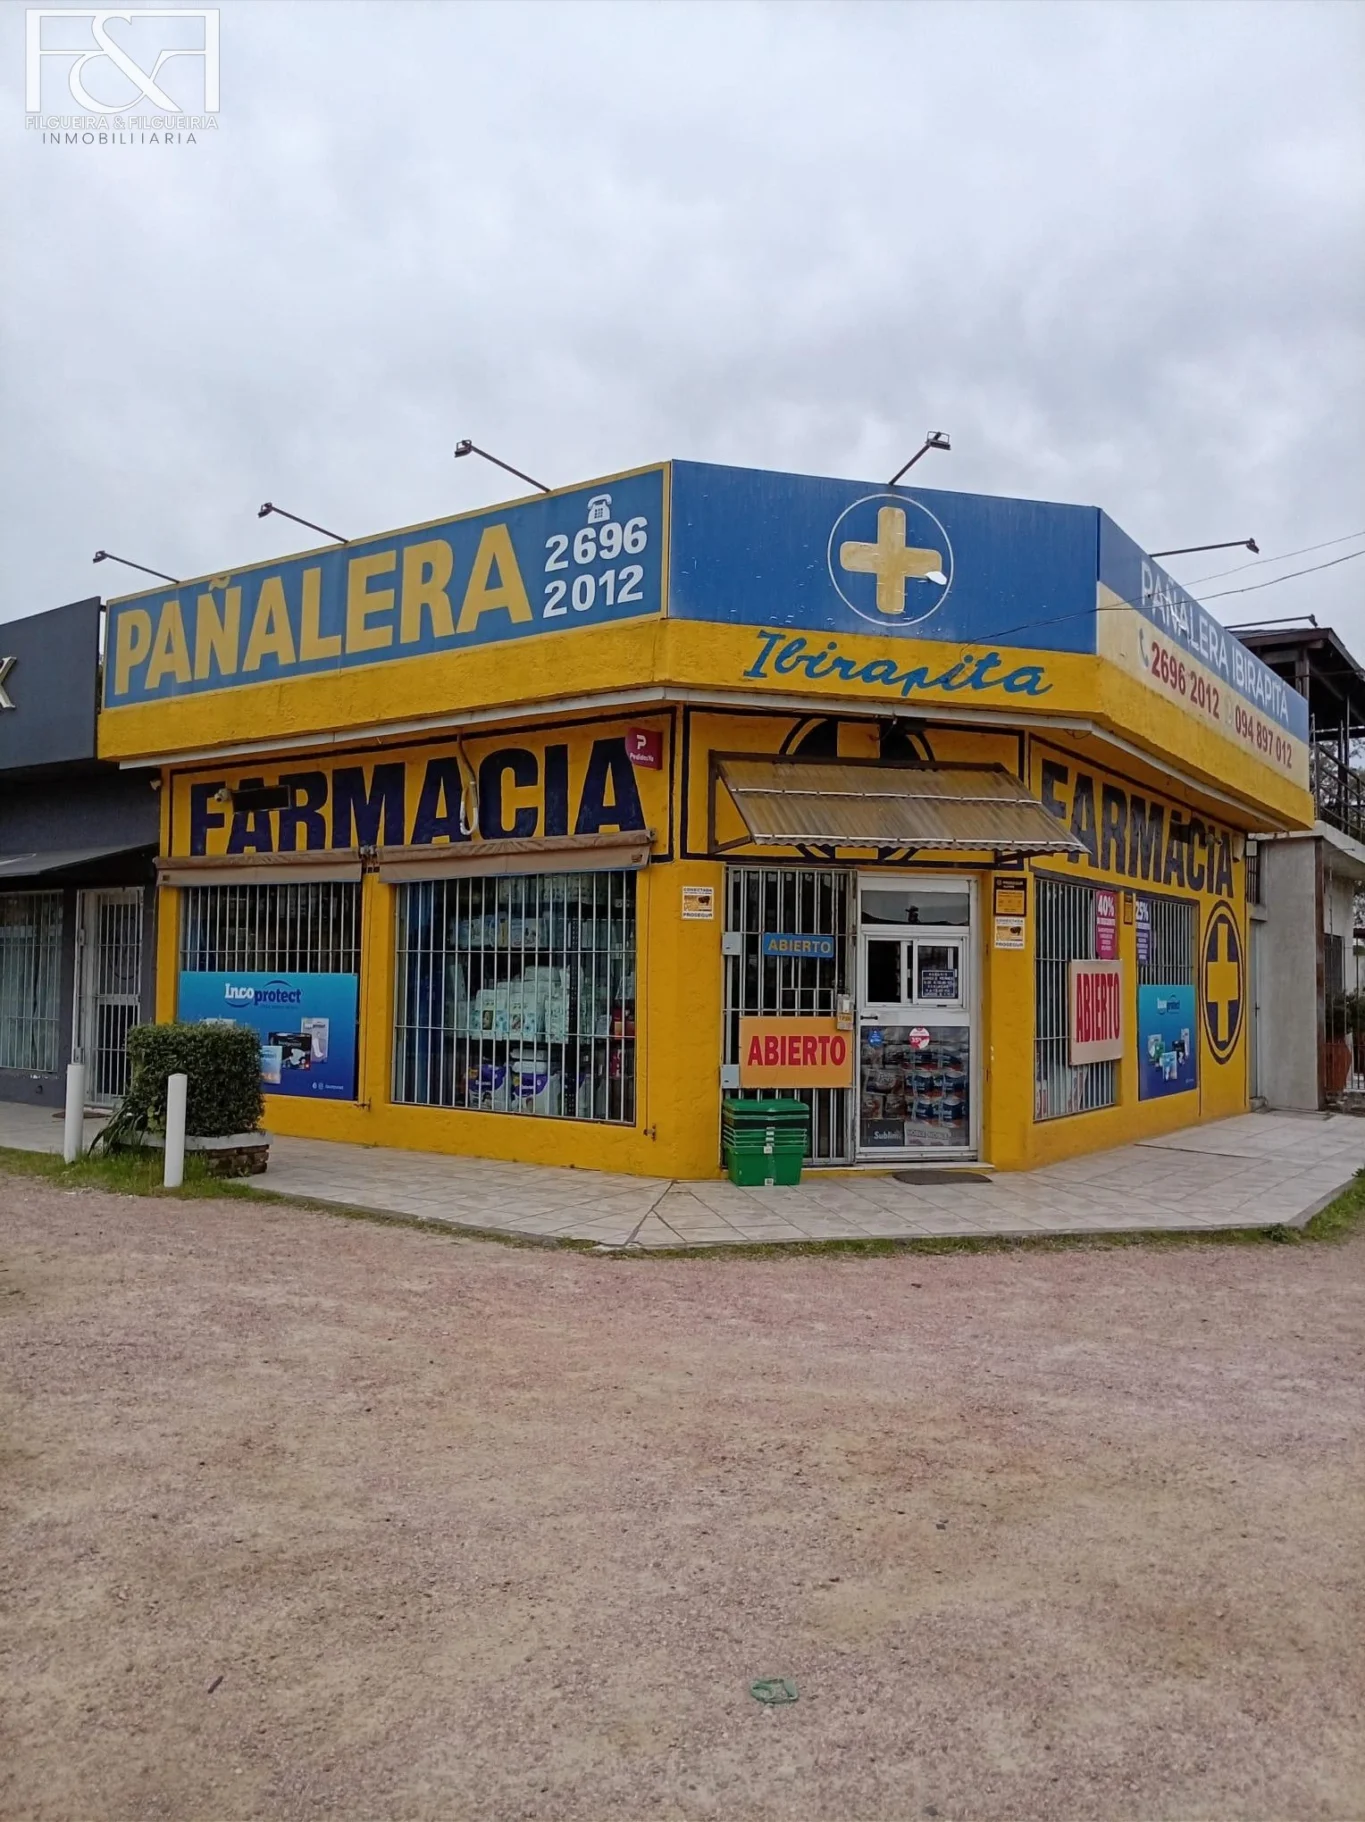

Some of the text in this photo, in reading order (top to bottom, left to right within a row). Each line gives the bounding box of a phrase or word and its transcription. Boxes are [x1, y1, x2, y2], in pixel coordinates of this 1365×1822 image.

[545, 516, 648, 573] 2696
[114, 523, 534, 696] PAÑALERA
[543, 564, 644, 619] 2012
[743, 629, 1053, 697] Ibirapita
[1151, 640, 1293, 769] 2696 2012 094 897 012
[190, 736, 647, 857] FARMACIA
[1042, 758, 1234, 899] FARMACIA
[1098, 894, 1115, 917] 40%
[767, 939, 831, 954] ABIERTO
[1076, 972, 1120, 1044] ABIERTO
[747, 1035, 846, 1066] ABIERTO
